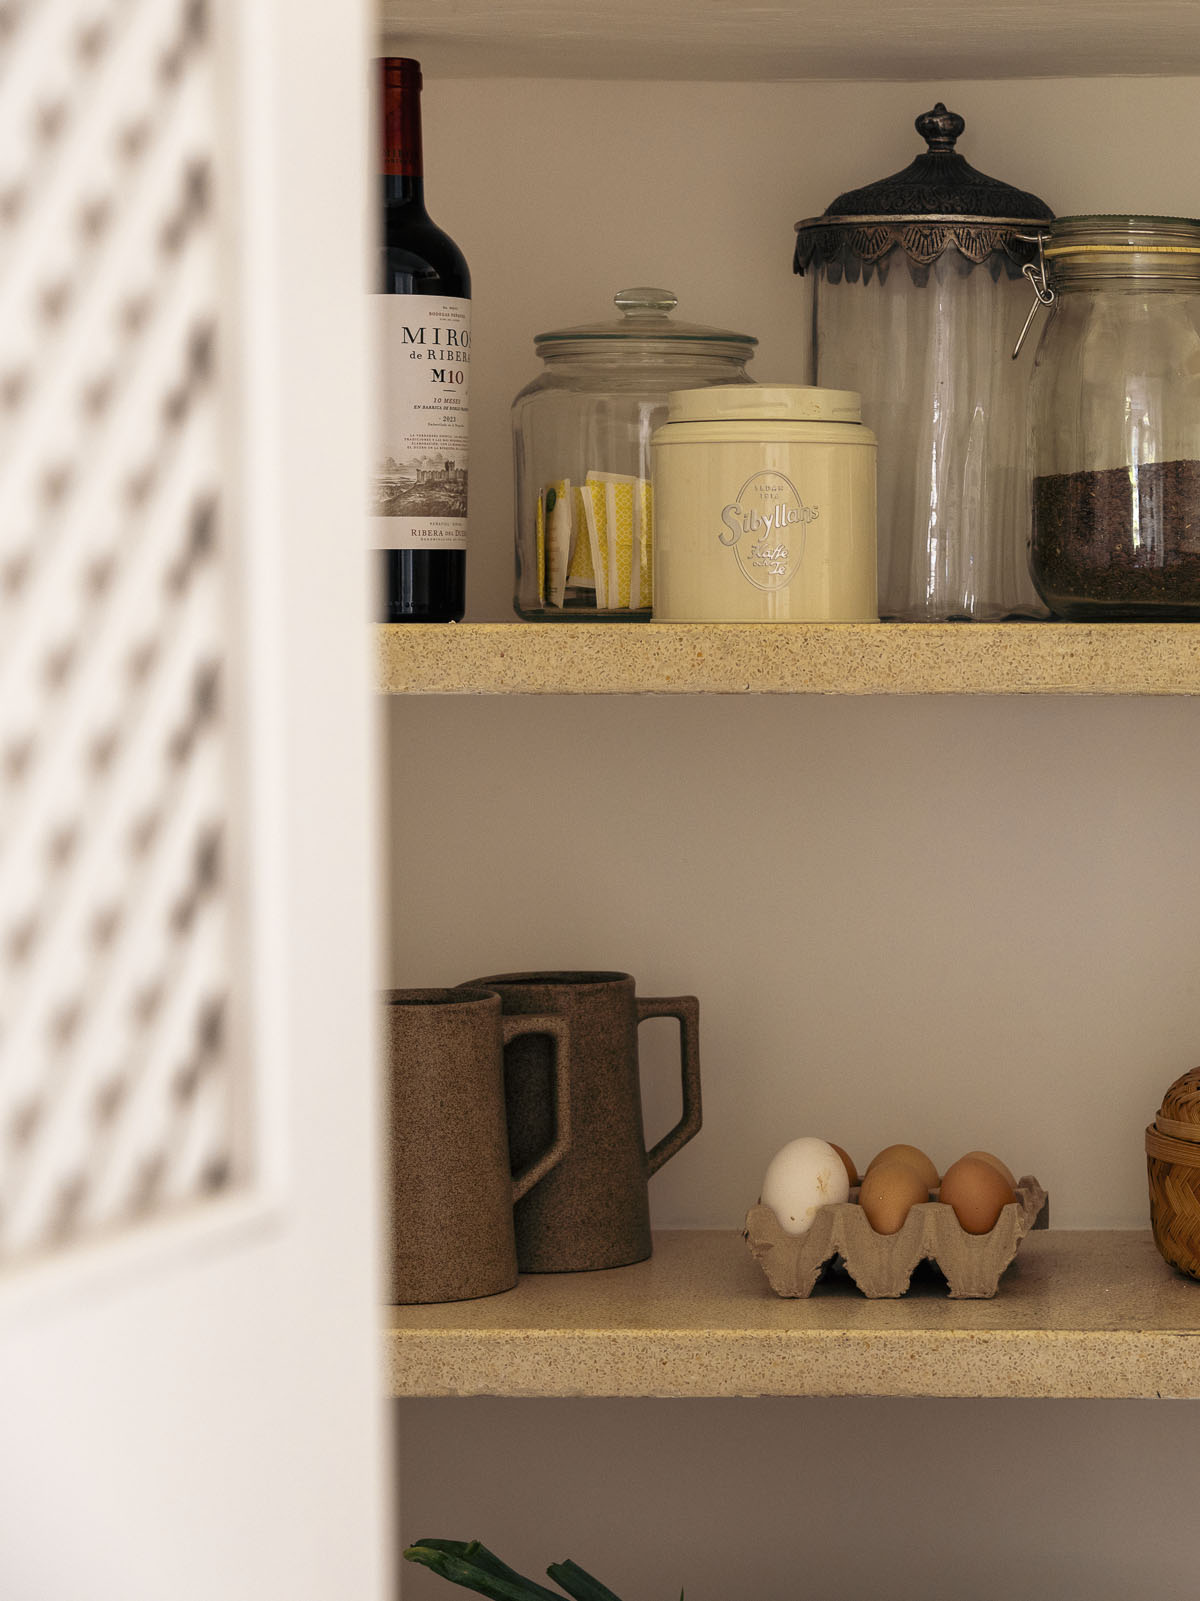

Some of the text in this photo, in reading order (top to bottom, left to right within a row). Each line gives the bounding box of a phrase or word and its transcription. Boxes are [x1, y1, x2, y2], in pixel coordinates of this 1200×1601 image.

[409, 350, 423, 360] de
[430, 368, 464, 385] M10
[718, 503, 820, 547] Sibyllans
[411, 528, 444, 537] RIBERA
[455, 529, 467, 537] DUE
